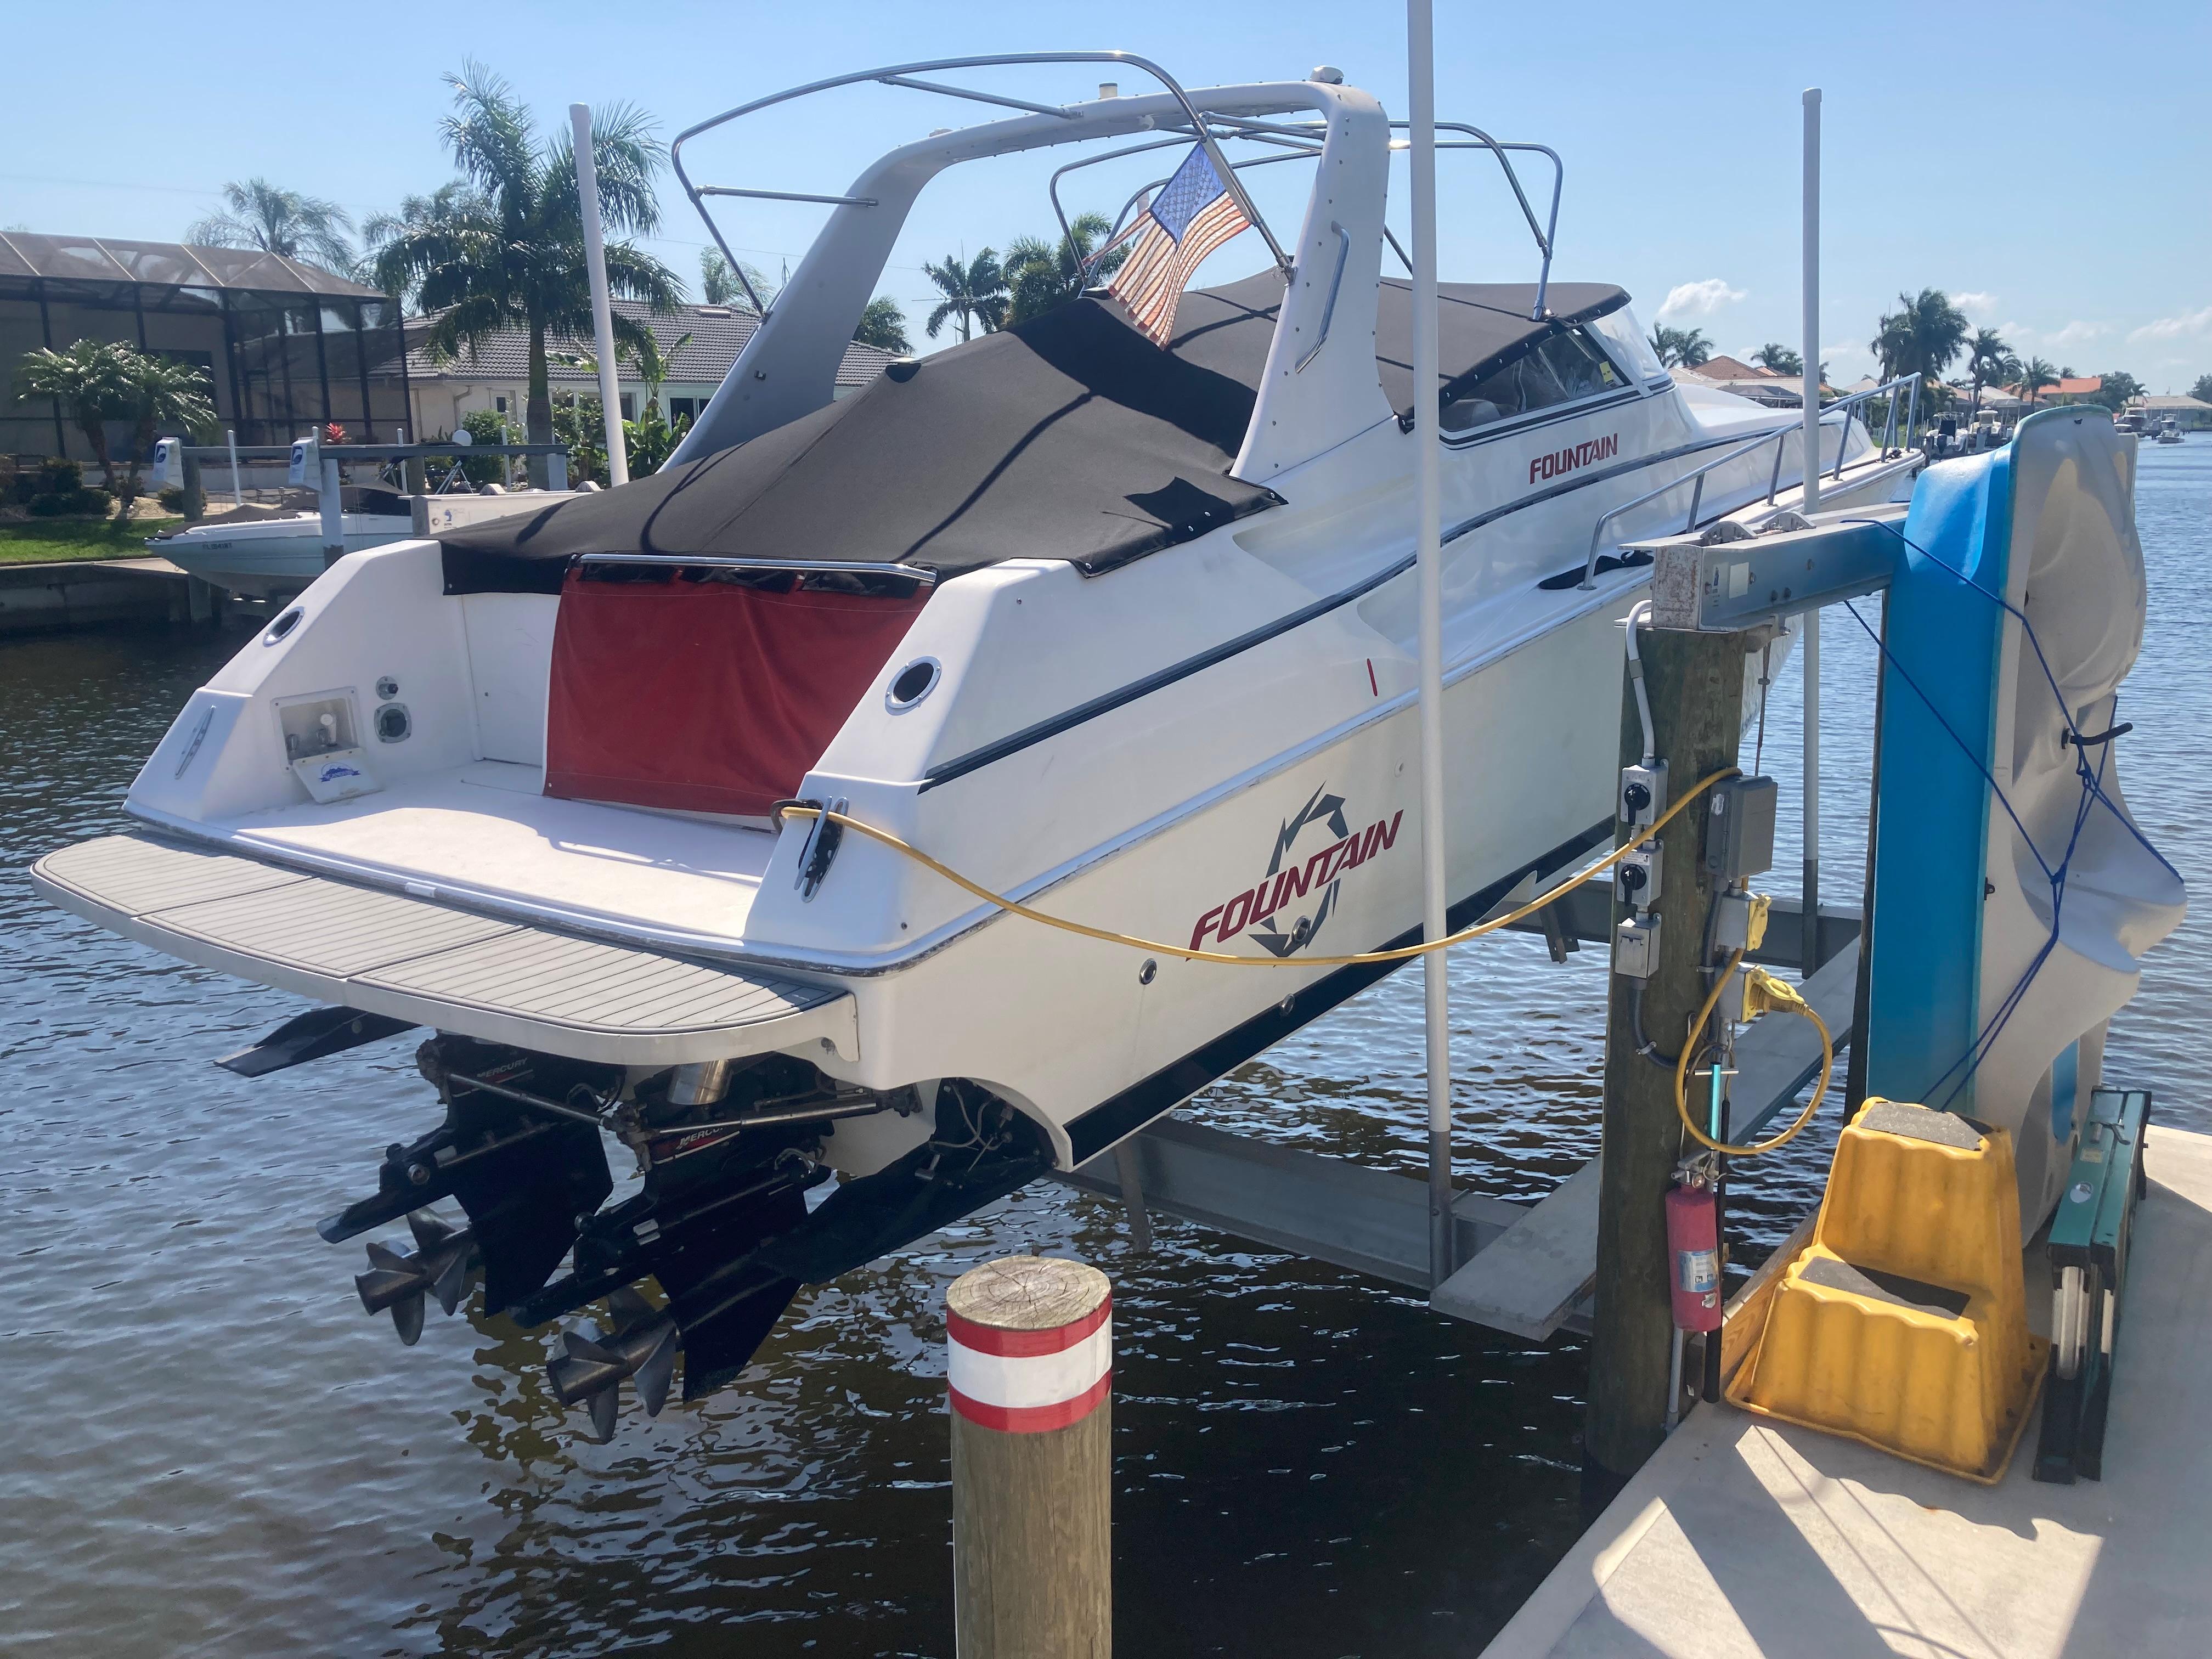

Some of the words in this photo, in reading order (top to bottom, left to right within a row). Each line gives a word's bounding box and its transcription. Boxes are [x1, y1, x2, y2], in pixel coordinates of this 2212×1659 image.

[1530, 432, 1618, 484] FOUNTAIN
[1185, 809, 1404, 962] FOUNTAIN
[476, 1057, 528, 1078] MERCURY
